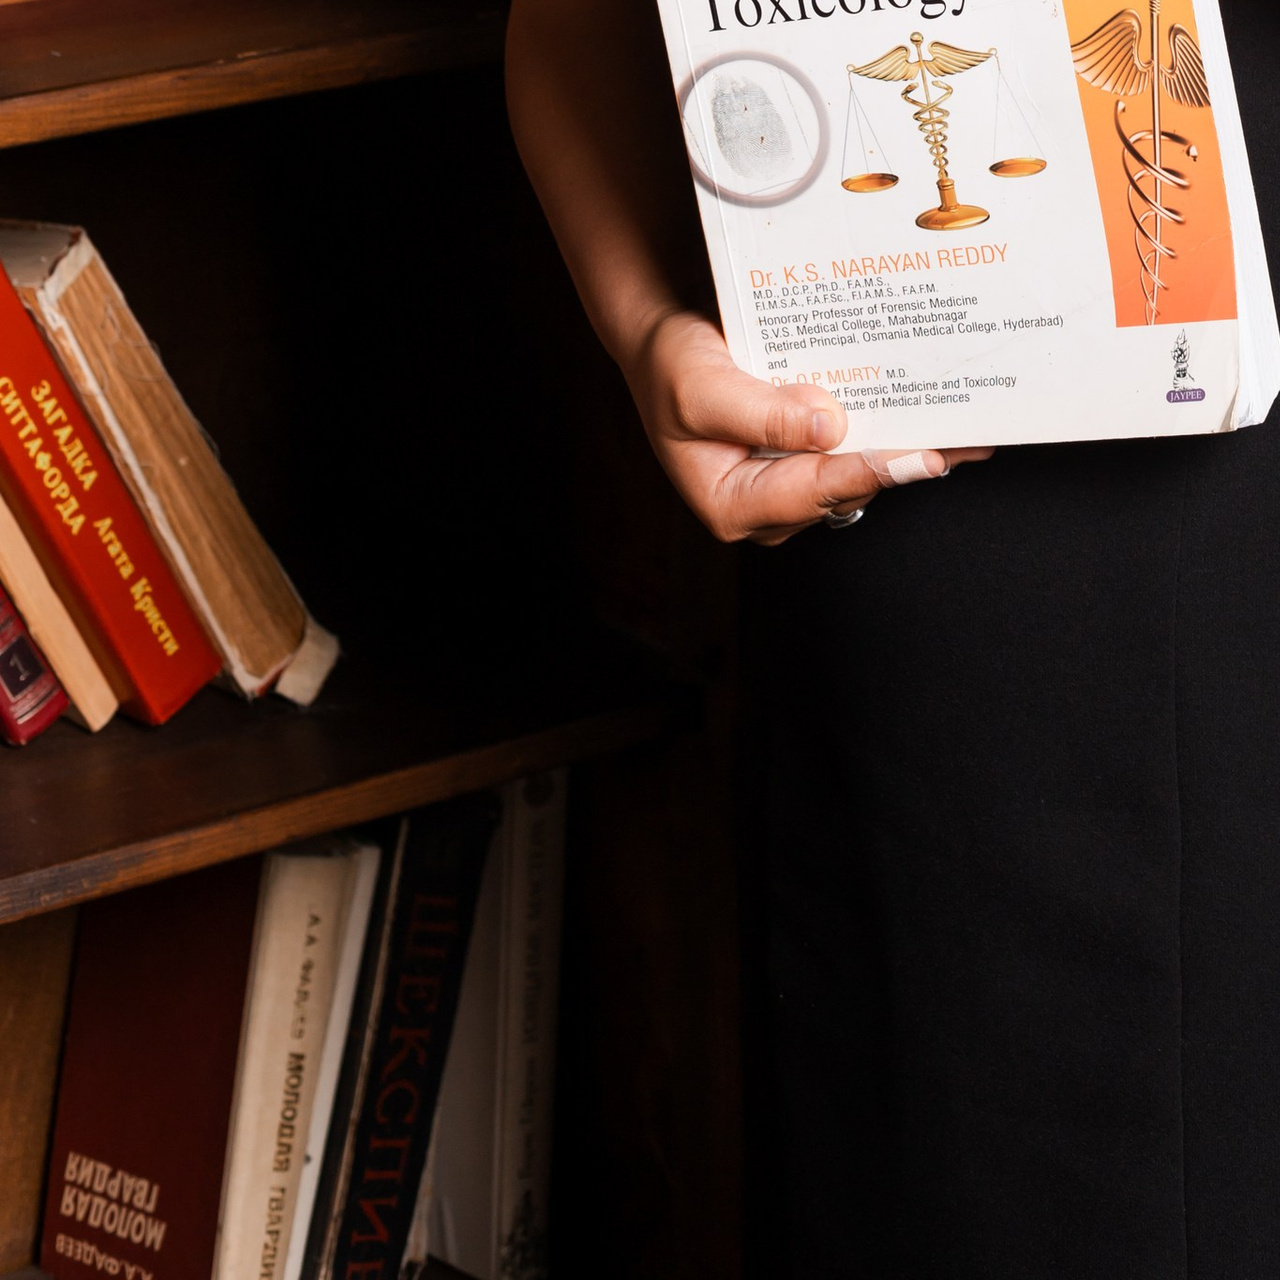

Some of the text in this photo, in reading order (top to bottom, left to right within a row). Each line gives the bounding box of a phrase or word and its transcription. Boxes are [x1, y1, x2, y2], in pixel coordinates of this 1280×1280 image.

[749, 242, 1009, 289] Dr. K.S. NARAYAN REDDY
[758, 294, 978, 328] Honorary Professor of Forensic Medicine
[760, 309, 969, 341] S.V.S. Medical College, Mahabubnagar
[763, 313, 1064, 355] (Retired Principal, Osmania Medical College, Hyderabad)
[768, 357, 788, 371] and
[827, 365, 882, 385] MURTY
[886, 367, 909, 380] M.D.
[830, 374, 1017, 400] of Forensic Medicine and Toxicology
[868, 397, 879, 409] of
[881, 394, 922, 408] Medical
[924, 391, 971, 406] Sciences
[1169, 390, 1203, 403] JAYPEE
[0, 374, 87, 537] СИТТАФОРДА
[32, 378, 99, 492] ЗАГАДКА
[93, 516, 180, 658] Агата Кристи
[272, 1051, 307, 1175] МОЛОДАЯ
[64, 1151, 161, 1212] ГВАРДИЯ
[59, 1183, 168, 1253] МОЛОДАЯ
